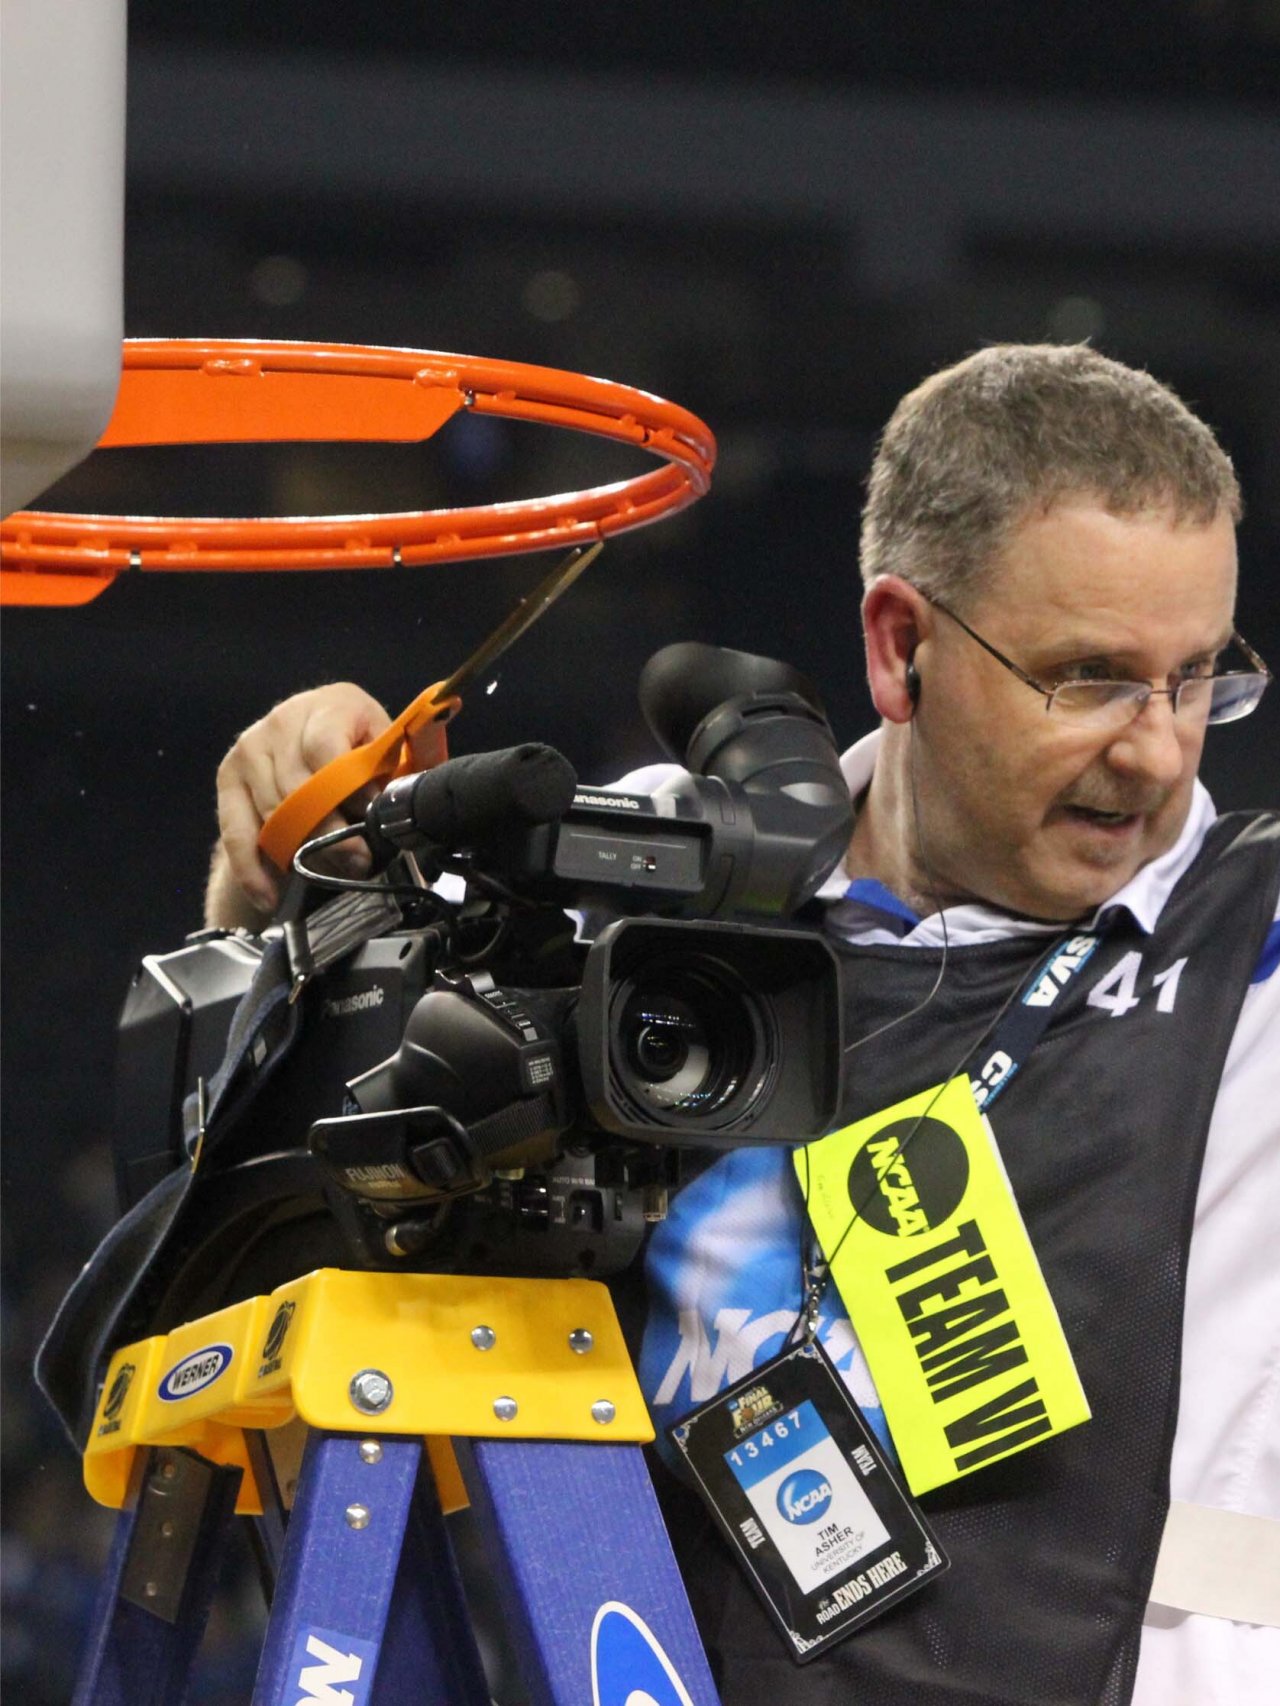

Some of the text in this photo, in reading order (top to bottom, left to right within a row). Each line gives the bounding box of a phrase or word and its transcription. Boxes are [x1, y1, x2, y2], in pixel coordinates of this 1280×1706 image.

[573, 794, 640, 809] anasonic
[1087, 950, 1188, 1017] 41
[866, 1136, 930, 1237] NCAA
[885, 1219, 1029, 1404] TEAM
[171, 1354, 220, 1391] WERNER
[850, 1443, 877, 1477] TEAM
[788, 1482, 832, 1521] NCAA
[739, 1516, 766, 1550] TEAM
[815, 1526, 854, 1557] ASHER
[817, 1522, 839, 1541] TIM
[816, 1551, 908, 1625] ROAD ENDS HERE
